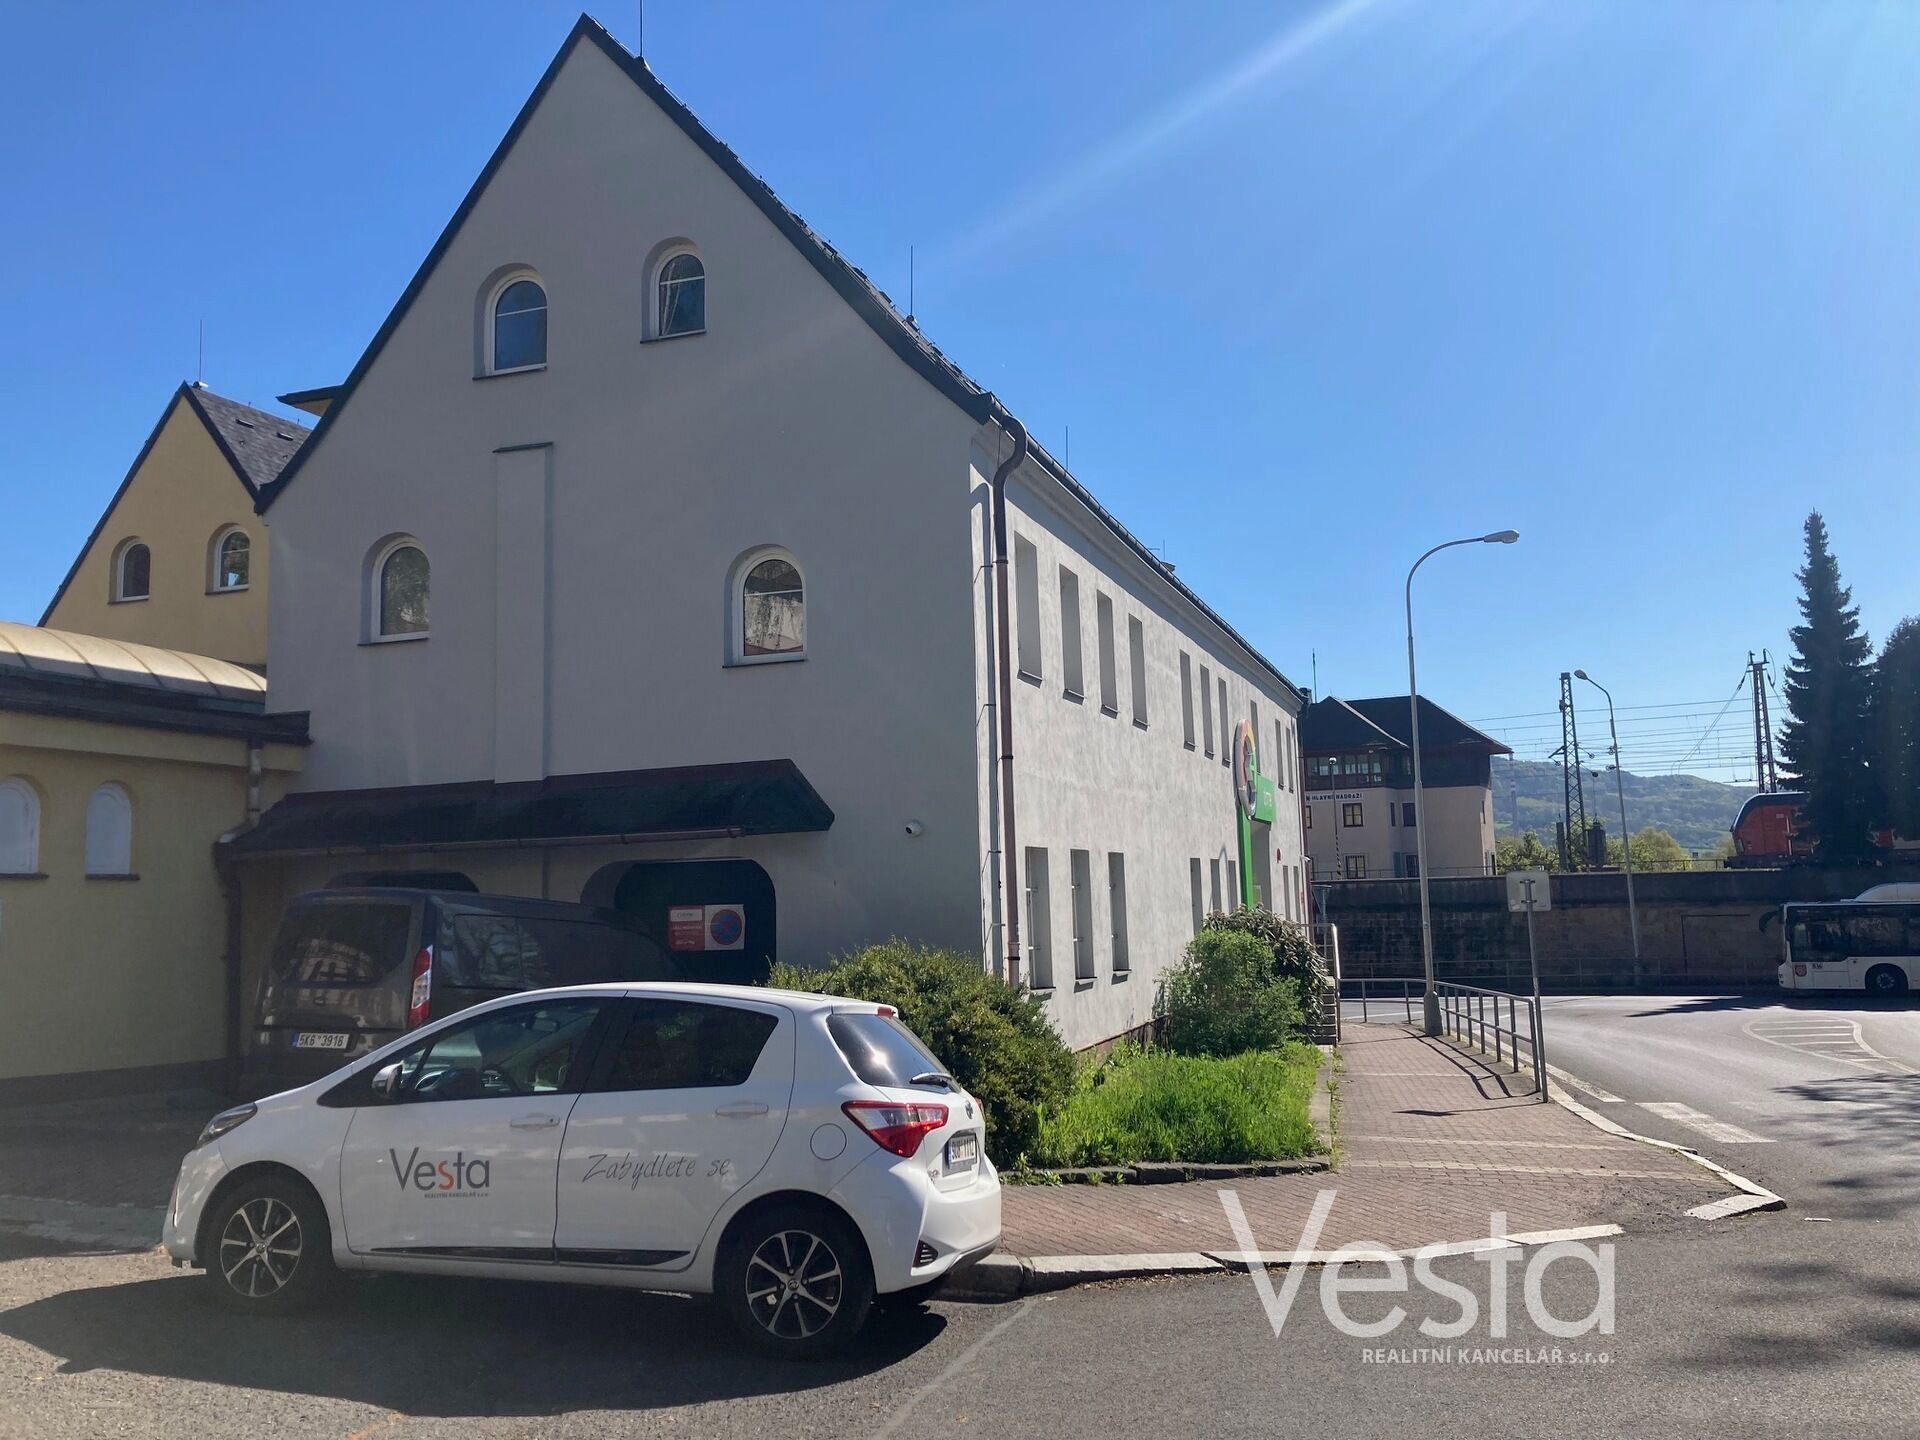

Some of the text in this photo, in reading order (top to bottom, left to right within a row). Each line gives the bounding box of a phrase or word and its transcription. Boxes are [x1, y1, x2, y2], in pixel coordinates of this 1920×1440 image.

[299, 1034, 344, 1047] 5K6 3916
[389, 1147, 490, 1192] Vesta
[582, 1151, 731, 1191] Zabydlete se
